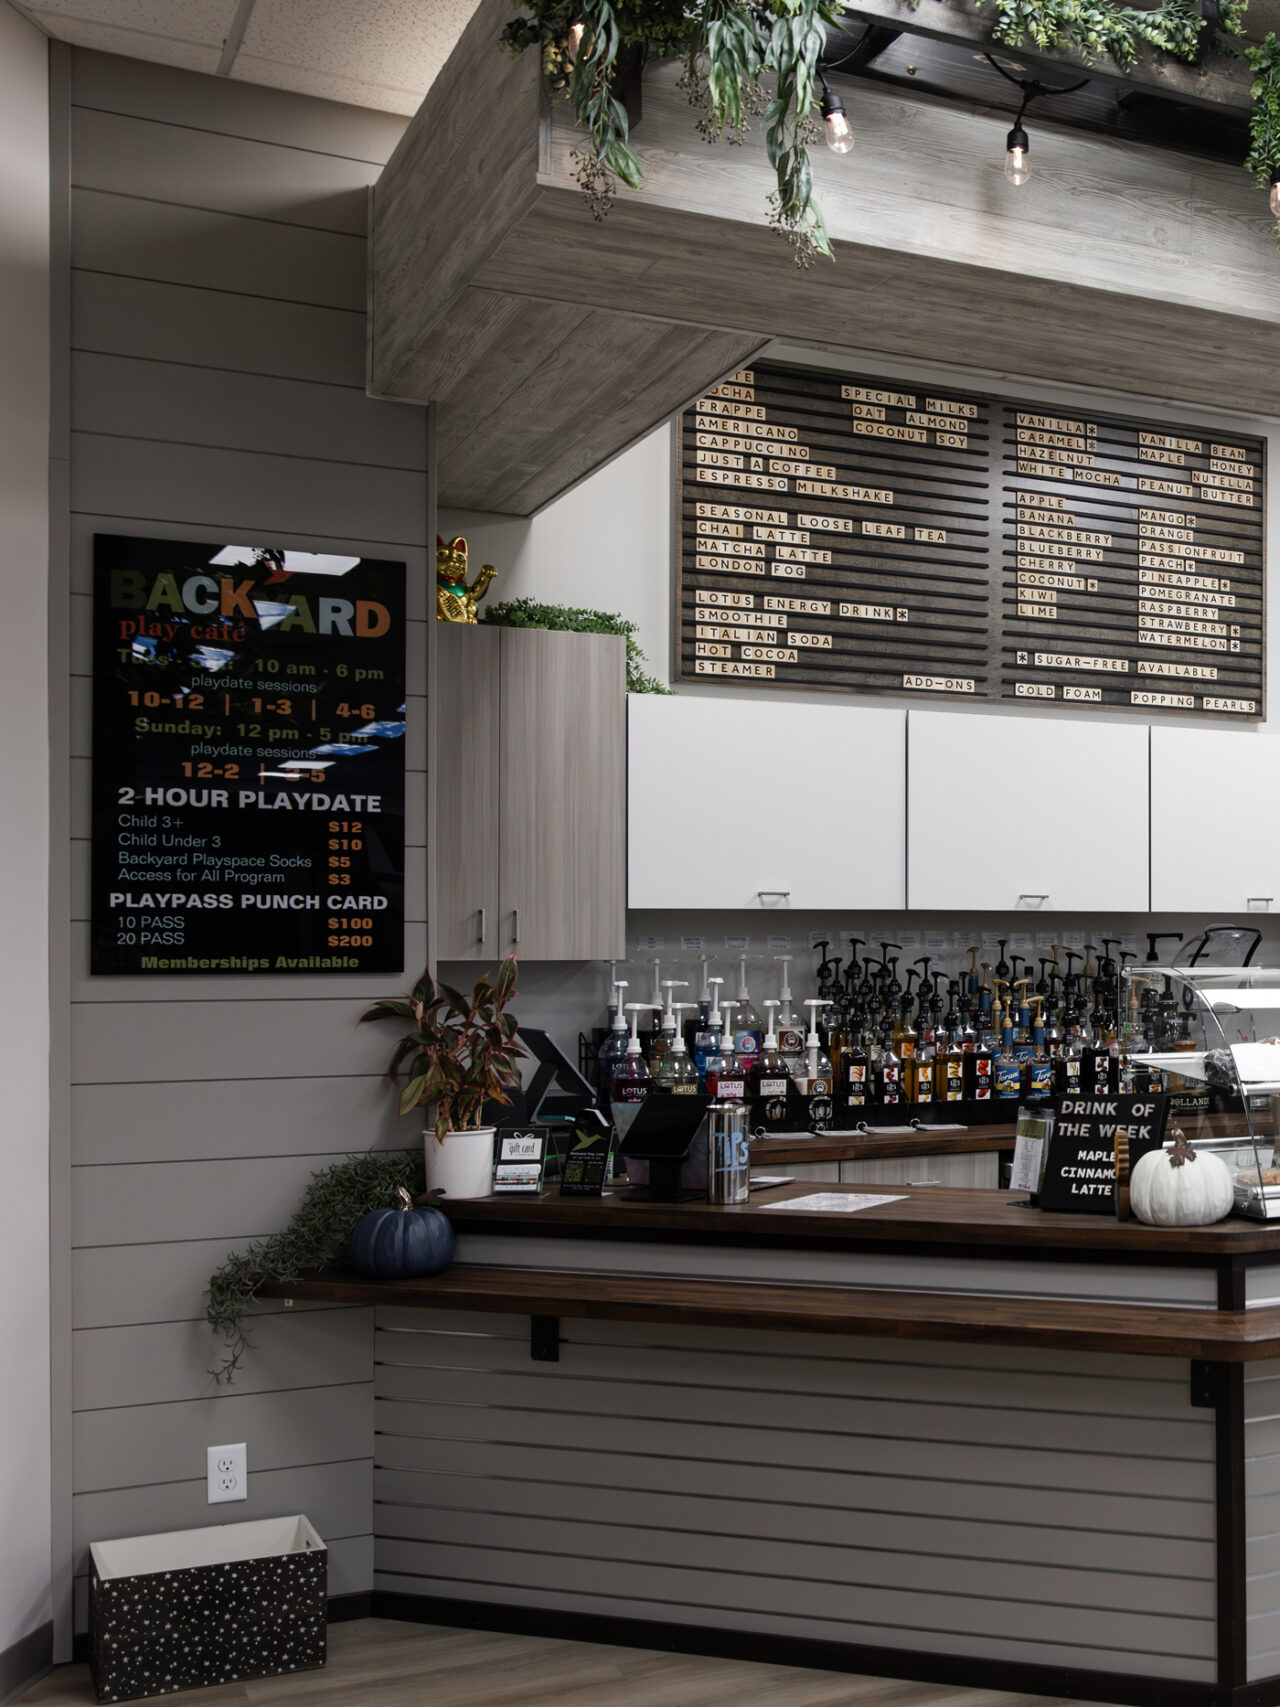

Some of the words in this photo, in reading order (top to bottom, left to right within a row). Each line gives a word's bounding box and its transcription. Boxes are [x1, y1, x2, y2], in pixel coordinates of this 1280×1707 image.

[699, 401, 763, 418] FRAPPE
[844, 388, 915, 407] SPECIAL
[927, 401, 975, 416] MILKS
[853, 406, 884, 419] OAT
[698, 418, 797, 440] AMERICANO
[908, 414, 966, 431] ALMOND
[1018, 415, 1083, 434] VANILLA
[855, 422, 925, 441] COCONUT
[938, 435, 966, 447] SOY
[1018, 431, 1083, 449] CARAMEL
[698, 435, 808, 458] CAPPUCCINO
[1141, 434, 1201, 452] VANILLA
[1212, 446, 1245, 459] BEAN
[1019, 447, 1093, 465] HAZELNUT
[1141, 450, 1183, 464] MAPLE
[700, 453, 742, 467] JUST
[753, 460, 761, 470] A
[771, 462, 834, 478] COFFEE
[1018, 463, 1065, 477] WHITE
[1075, 471, 1120, 485] MOCHA
[1212, 460, 1252, 475] HONEY
[700, 470, 787, 489] ESPRESSO
[797, 482, 891, 502] MILKSHAKE
[1193, 472, 1251, 490] NUTELLA
[1019, 494, 1064, 508] APPLE
[1141, 480, 1191, 496] PEANUT
[1202, 489, 1252, 505] BUTTER
[699, 505, 786, 523] SEASONAL
[800, 517, 850, 531] LOOSE
[865, 524, 903, 537] LEAF
[917, 529, 945, 542] TEA
[1019, 510, 1074, 525] BANANA
[1141, 511, 1184, 525] MANGO
[699, 523, 740, 536] CHAI
[756, 529, 807, 543] LATTE
[1019, 526, 1110, 545] BLACKBERRY
[1140, 526, 1192, 541] ORANGE
[698, 541, 764, 556] MATCHA
[778, 547, 829, 562] LATTE
[1019, 541, 1102, 559] BLUEBERRY
[1141, 541, 1243, 562] PASSIONFRUIT
[699, 558, 764, 573] LONDON
[774, 564, 804, 576] FOG
[1019, 557, 1075, 572] CHERRY
[1141, 556, 1183, 570] PEACH
[1019, 573, 1083, 588] COCONUT
[1142, 571, 1218, 588] PINEAPPLE
[699, 592, 752, 606] LOTUS
[767, 598, 829, 613] ENERGY
[1019, 589, 1055, 601] KIWI
[1141, 586, 1234, 606] POMEGRANATE
[698, 610, 784, 626] SMOOTHIE
[1020, 605, 1055, 617] LIME
[1141, 602, 1217, 619] RASPBERRY
[117, 615, 180, 642] play
[1141, 617, 1225, 634] STRAWBERRY
[700, 628, 775, 642] ITALIAN
[790, 635, 830, 647] SODA
[1140, 632, 1226, 649] WATERMELON
[698, 644, 729, 656] HOT
[743, 648, 796, 661] COCOA
[255, 659, 280, 673] 10
[286, 664, 316, 676] am
[336, 665, 348, 678] 6
[355, 668, 384, 682] pm
[698, 662, 773, 677] STEAMER
[1140, 663, 1216, 678] AVAILABLE
[191, 675, 254, 691] playdate
[257, 680, 317, 694] sessions
[905, 677, 973, 690] ADD-ONS
[127, 690, 205, 711] 10-12
[1017, 685, 1054, 696] COLD
[1066, 689, 1100, 700] FOAM
[251, 697, 292, 716] 1-3
[1133, 693, 1194, 707] POPPING
[1205, 699, 1253, 711] PEARLS
[336, 702, 376, 720] 4-6
[134, 717, 222, 738] Sunday:
[237, 723, 262, 738] 12
[268, 728, 299, 742] pm
[319, 728, 332, 742] 5
[190, 742, 253, 758] playdate
[256, 747, 317, 760] sessions
[181, 761, 240, 780] 12-2
[117, 787, 135, 805] 2
[145, 788, 230, 808] HOUR
[238, 791, 382, 812] PLAYDATE
[118, 814, 157, 828] Child
[162, 816, 185, 828] 3+
[328, 820, 363, 834] $12
[118, 832, 157, 846] Child
[162, 834, 208, 848] Under
[211, 835, 222, 847] 3
[328, 838, 363, 852] $10
[118, 852, 189, 869] Backyard
[193, 853, 265, 870] Playspace
[269, 855, 312, 868] Socks
[328, 856, 351, 869] $5
[118, 868, 171, 882] Access
[176, 869, 197, 882] for
[201, 870, 220, 883] All
[225, 871, 285, 886] Program
[328, 873, 351, 886] $3
[109, 892, 234, 909] PLAYPASS
[240, 893, 320, 910] PUNCH
[327, 895, 388, 910] CARD
[118, 916, 136, 928] 10
[141, 916, 185, 928] PASS
[328, 917, 373, 930] $100
[117, 932, 136, 945] 20
[141, 932, 185, 945] PASS
[328, 934, 373, 948] $200
[141, 956, 269, 971] Memberships
[276, 956, 359, 970] Available
[622, 1087, 647, 1095] LOTUS
[673, 1085, 697, 1093] LOTUS
[1060, 1100, 1118, 1116] DRINK
[1131, 1103, 1156, 1117] OF
[1058, 1122, 1091, 1137] THE
[1098, 1124, 1152, 1139] WEEK
[522, 1143, 535, 1153] card
[1077, 1150, 1116, 1162] MAPLE
[1060, 1167, 1116, 1179] CINNAMO
[1071, 1184, 1112, 1196] LATTE
